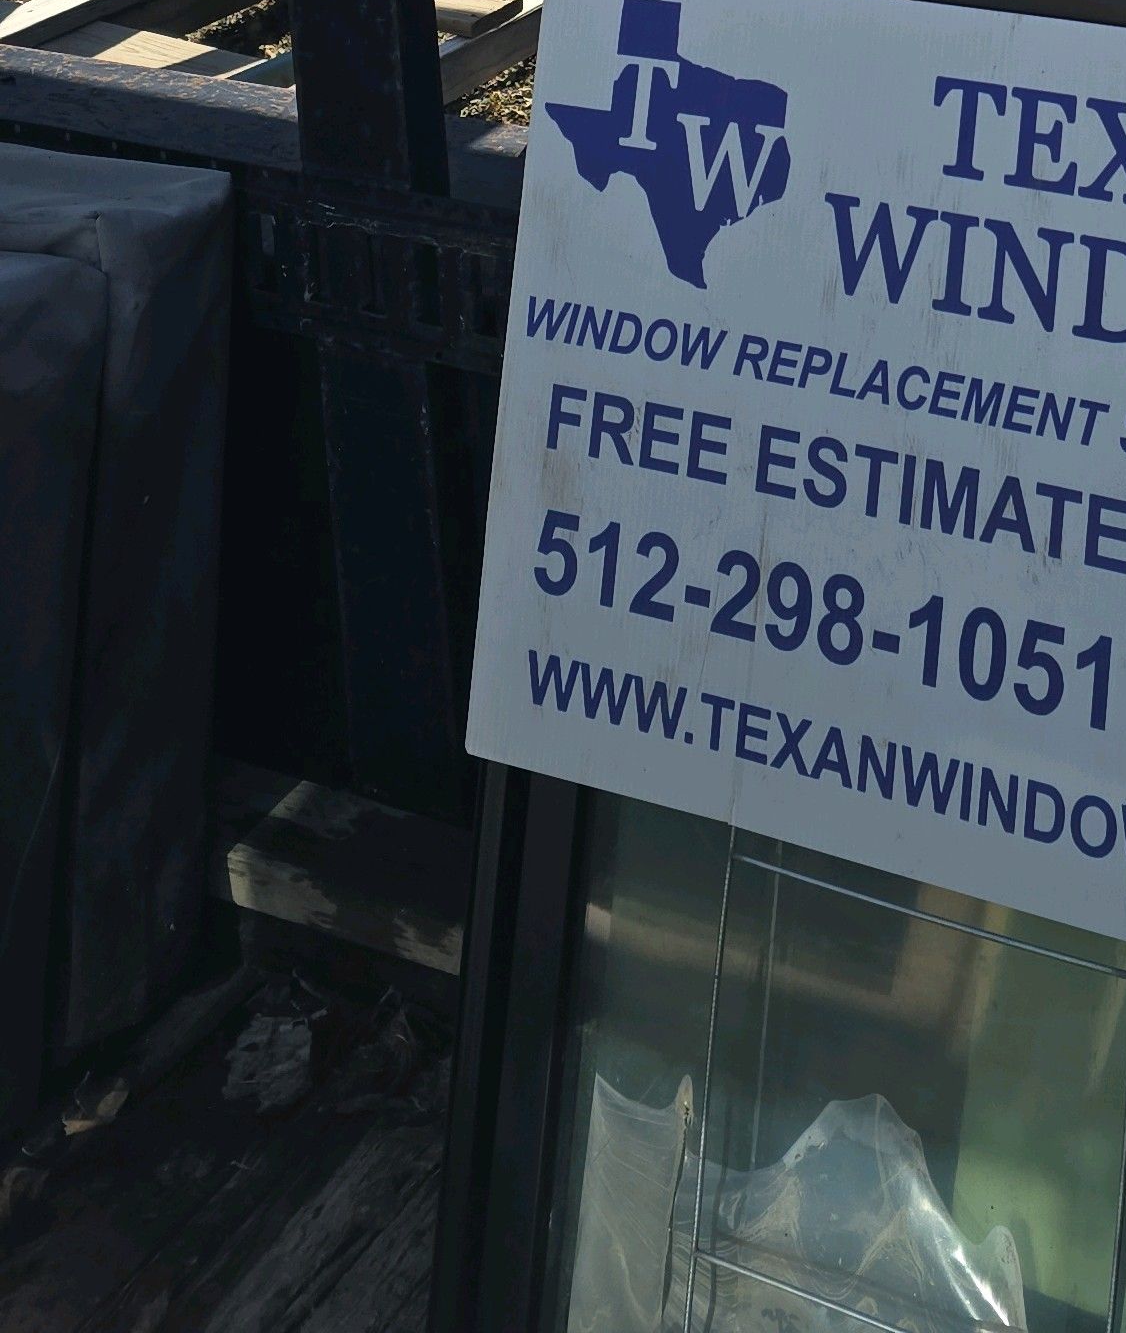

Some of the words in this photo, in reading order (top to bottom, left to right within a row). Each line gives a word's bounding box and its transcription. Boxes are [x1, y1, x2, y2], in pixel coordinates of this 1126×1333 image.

[617, 54, 785, 219] TW
[526, 295, 728, 371] WINDOW
[732, 333, 1111, 447] REPLACEMENT
[546, 383, 732, 486] FREE
[533, 508, 1113, 732] 512-298-1051
